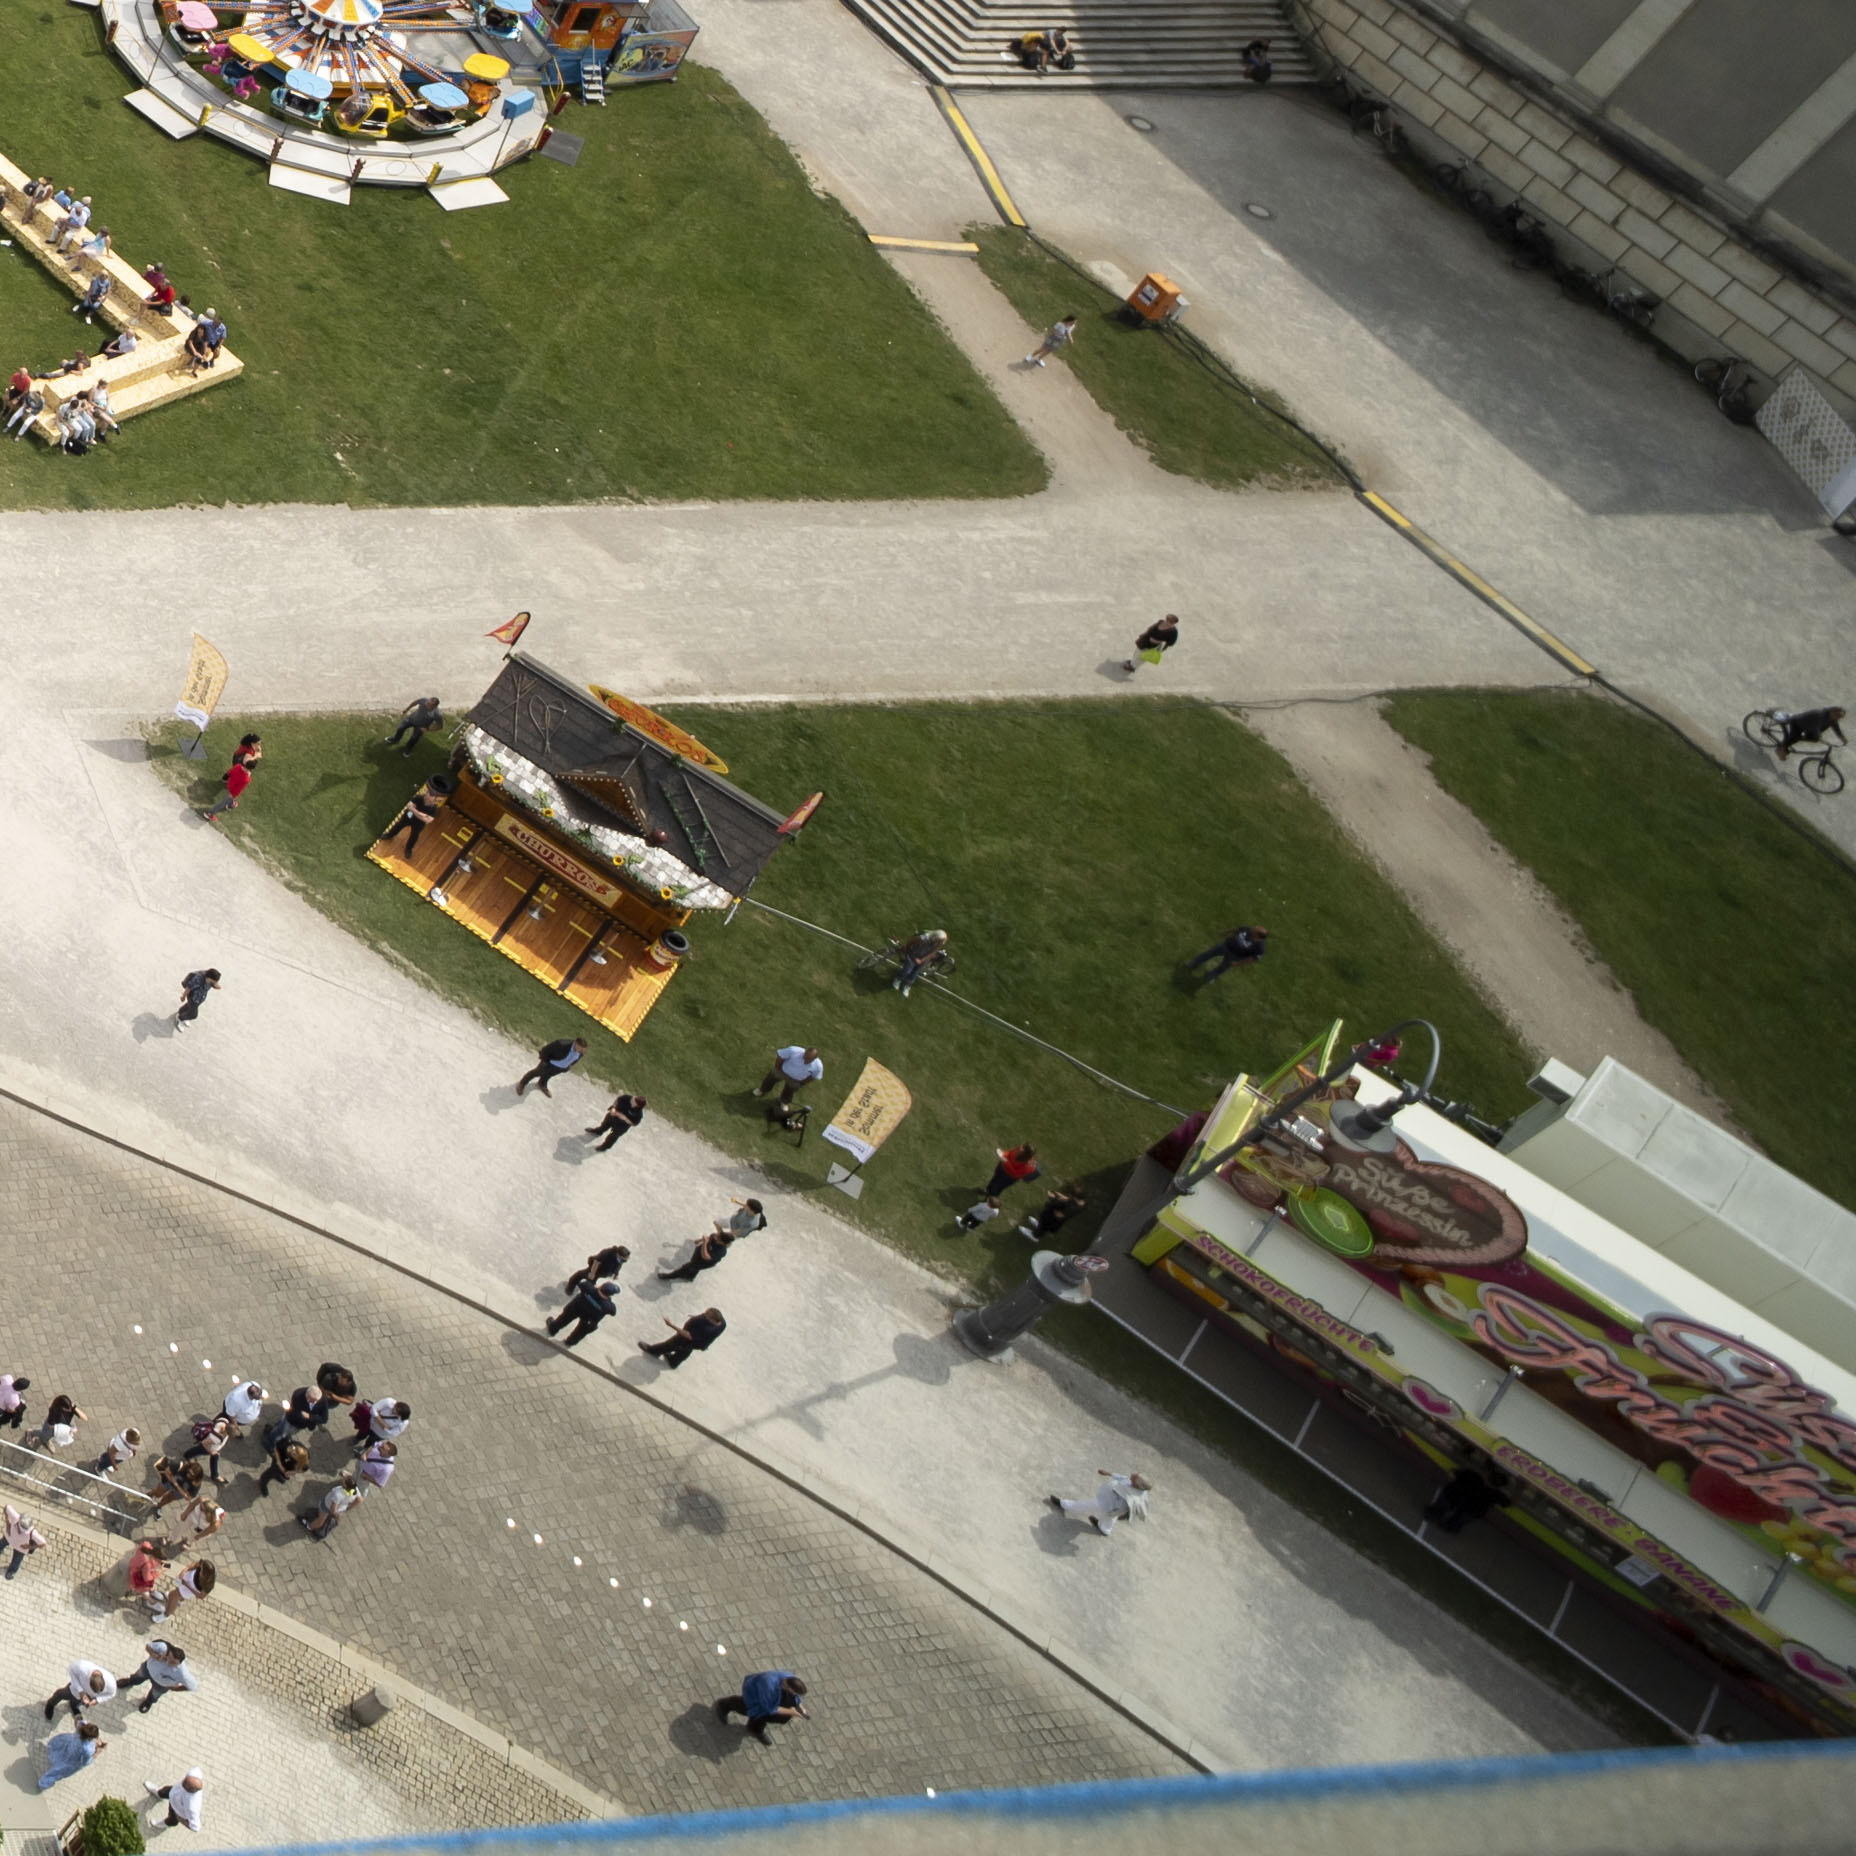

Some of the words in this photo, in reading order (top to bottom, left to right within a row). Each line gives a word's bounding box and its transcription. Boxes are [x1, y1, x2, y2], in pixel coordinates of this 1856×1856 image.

[515, 828, 601, 890] CHURROS
[1195, 1234, 1377, 1352] SCHOKOFRÜCHTE
[1495, 1444, 1626, 1529] ERDBEERE
[1633, 1536, 1736, 1611] BANANE
